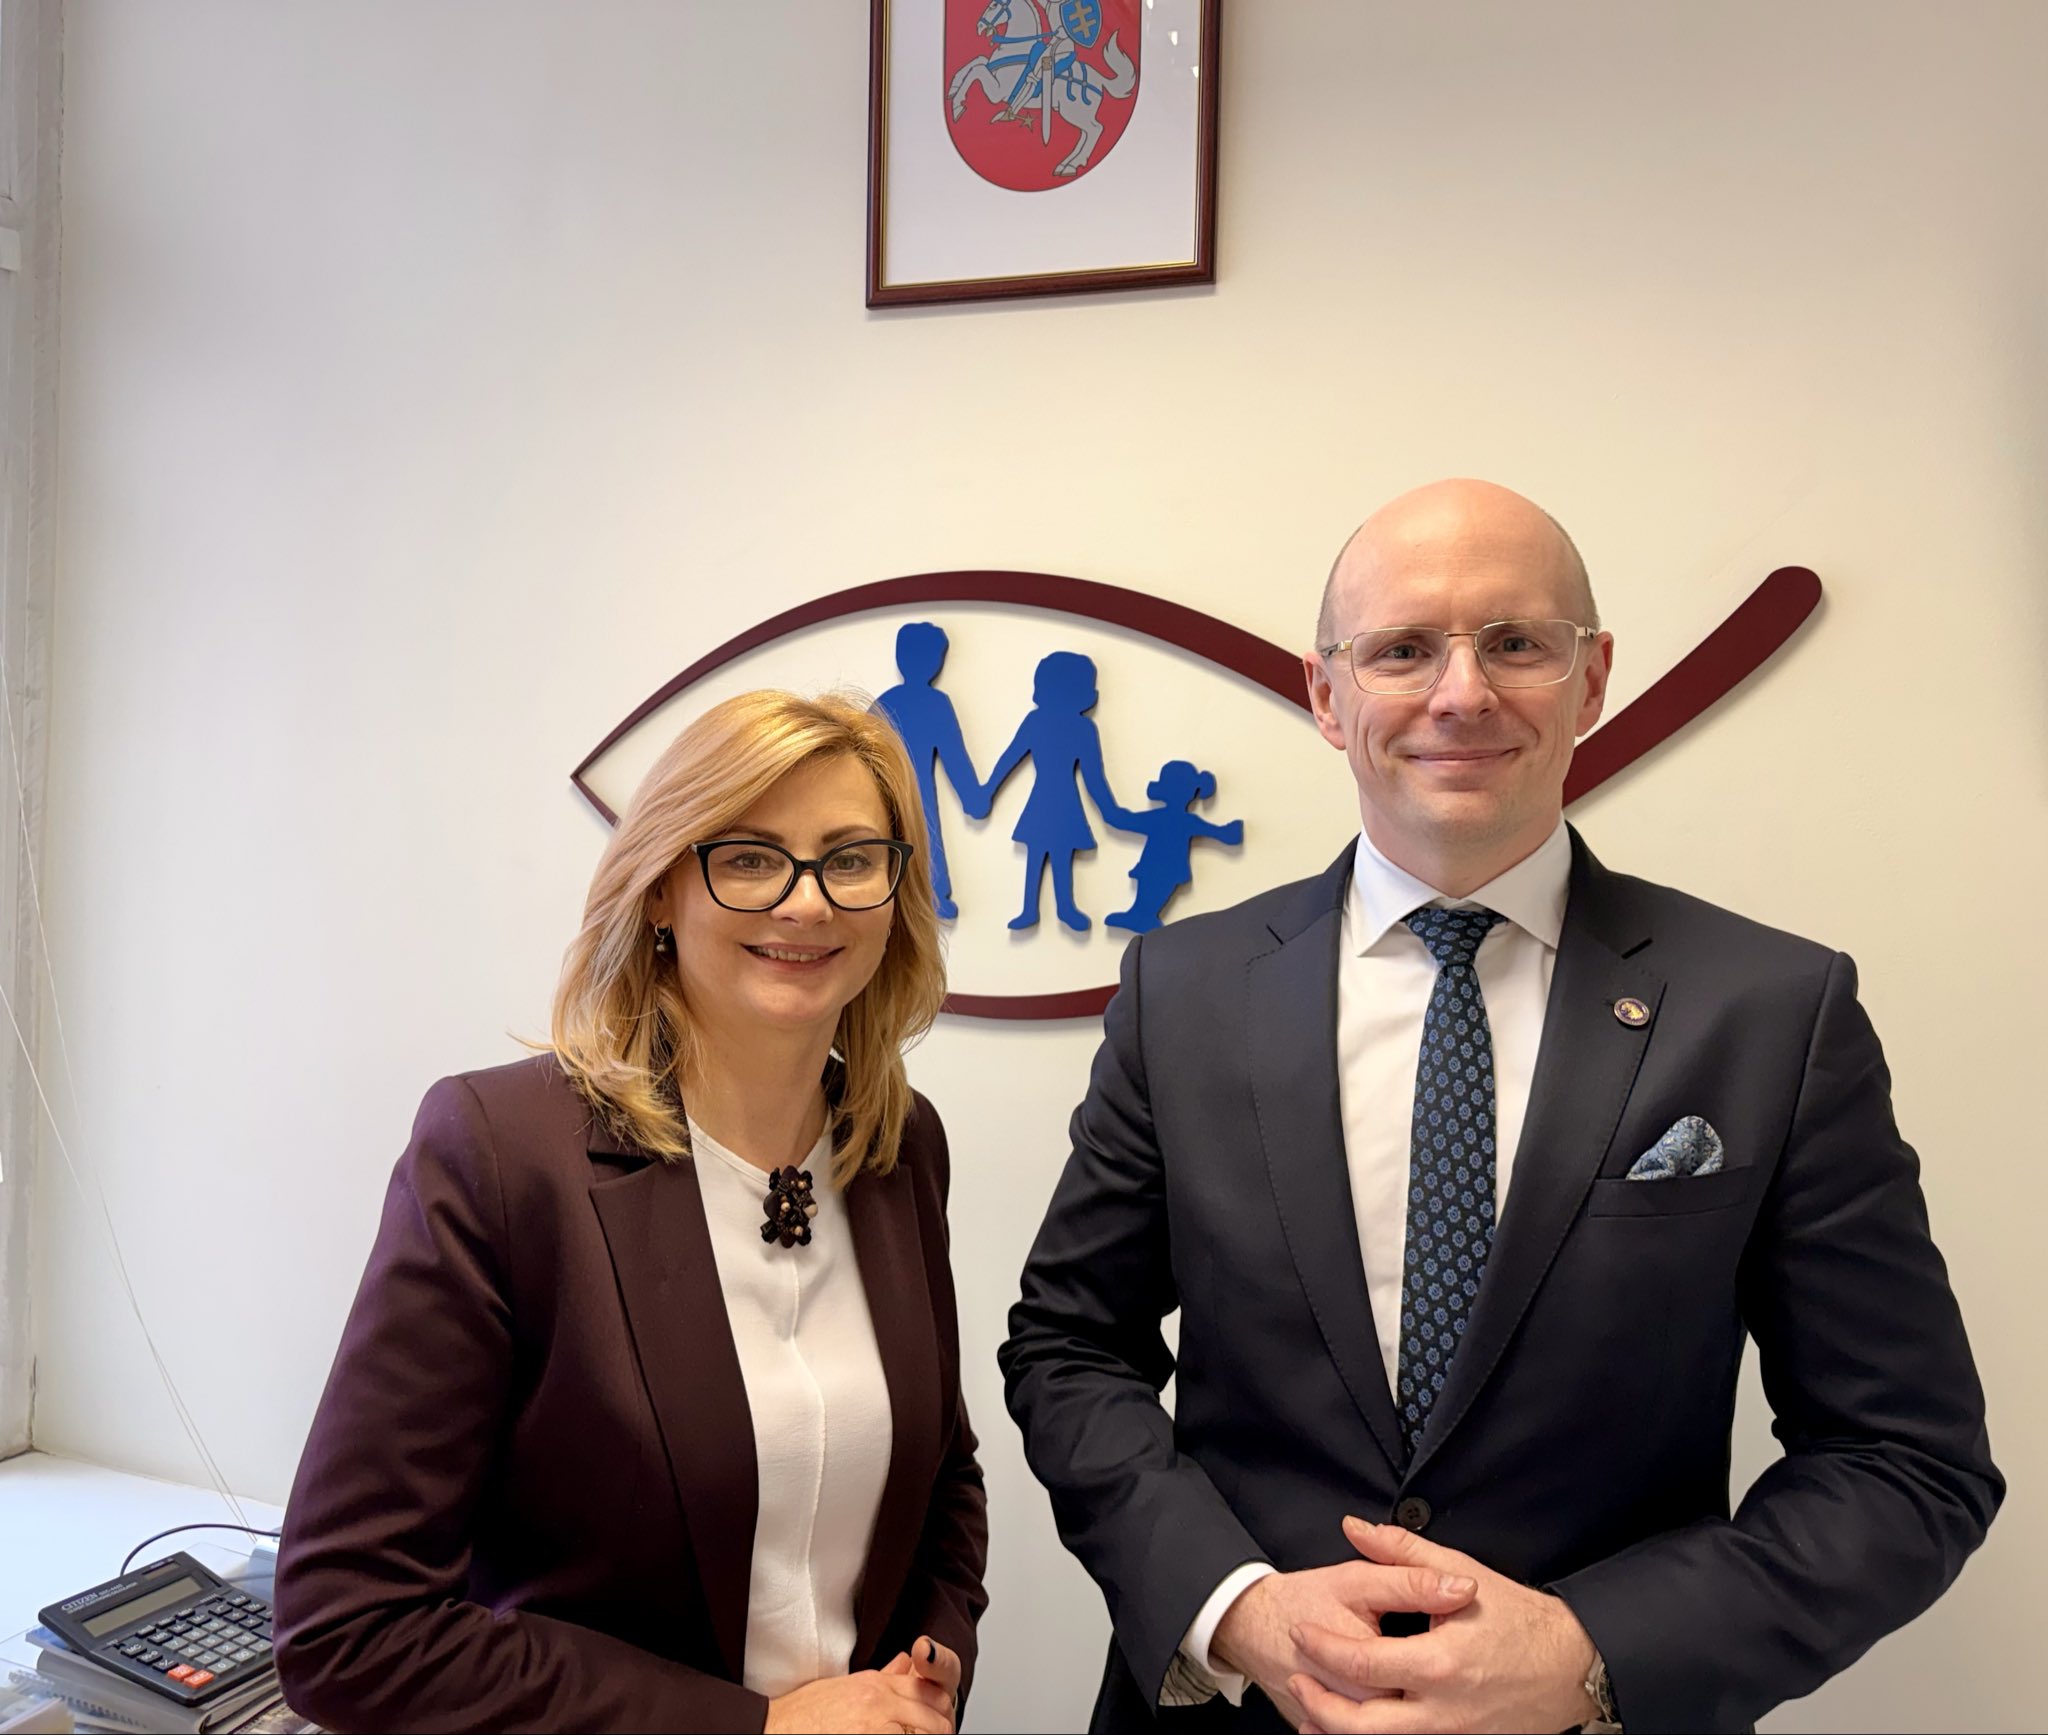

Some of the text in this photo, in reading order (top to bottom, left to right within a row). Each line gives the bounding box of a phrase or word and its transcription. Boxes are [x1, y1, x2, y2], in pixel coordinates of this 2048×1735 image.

[61, 1592, 98, 1612] CITIZEN
[126, 1643, 142, 1653] MC
[236, 1650, 249, 1659] 00
